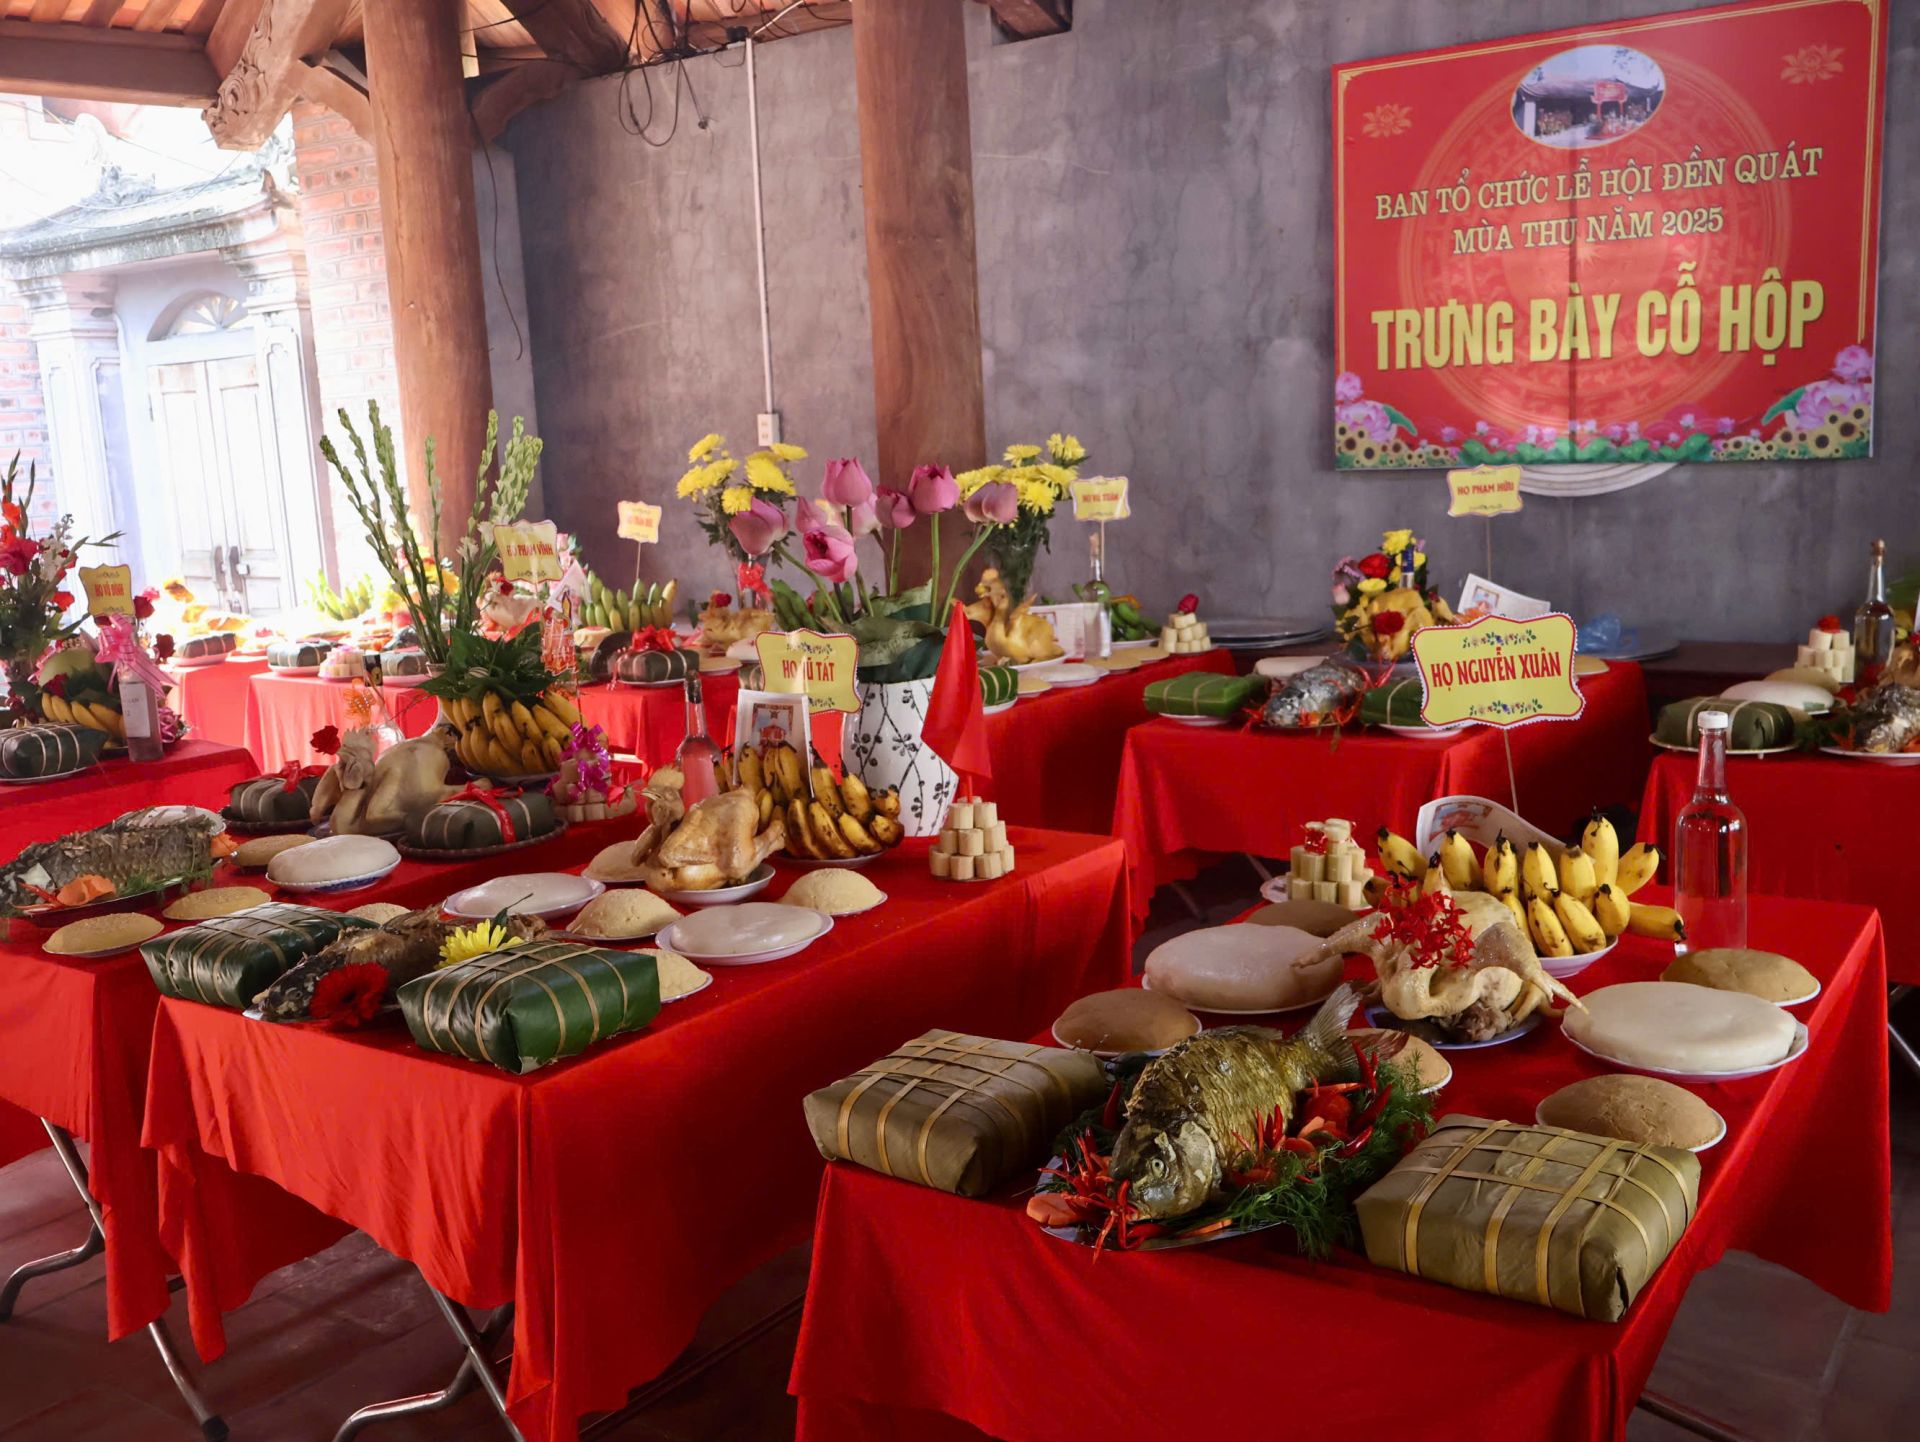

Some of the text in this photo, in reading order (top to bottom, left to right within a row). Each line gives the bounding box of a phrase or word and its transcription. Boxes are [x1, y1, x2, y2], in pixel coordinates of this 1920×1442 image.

[1376, 140, 1823, 219] BAN TỔ CHỨC LỄ HỘI ĐỀN QUÁT
[1453, 206, 1724, 254] MÙA THU NĂM 2025
[1371, 261, 1825, 370] TRƯNG BÀY CỖ HỘP
[1431, 646, 1562, 692] HỌ NGUYỄN XUÂN
